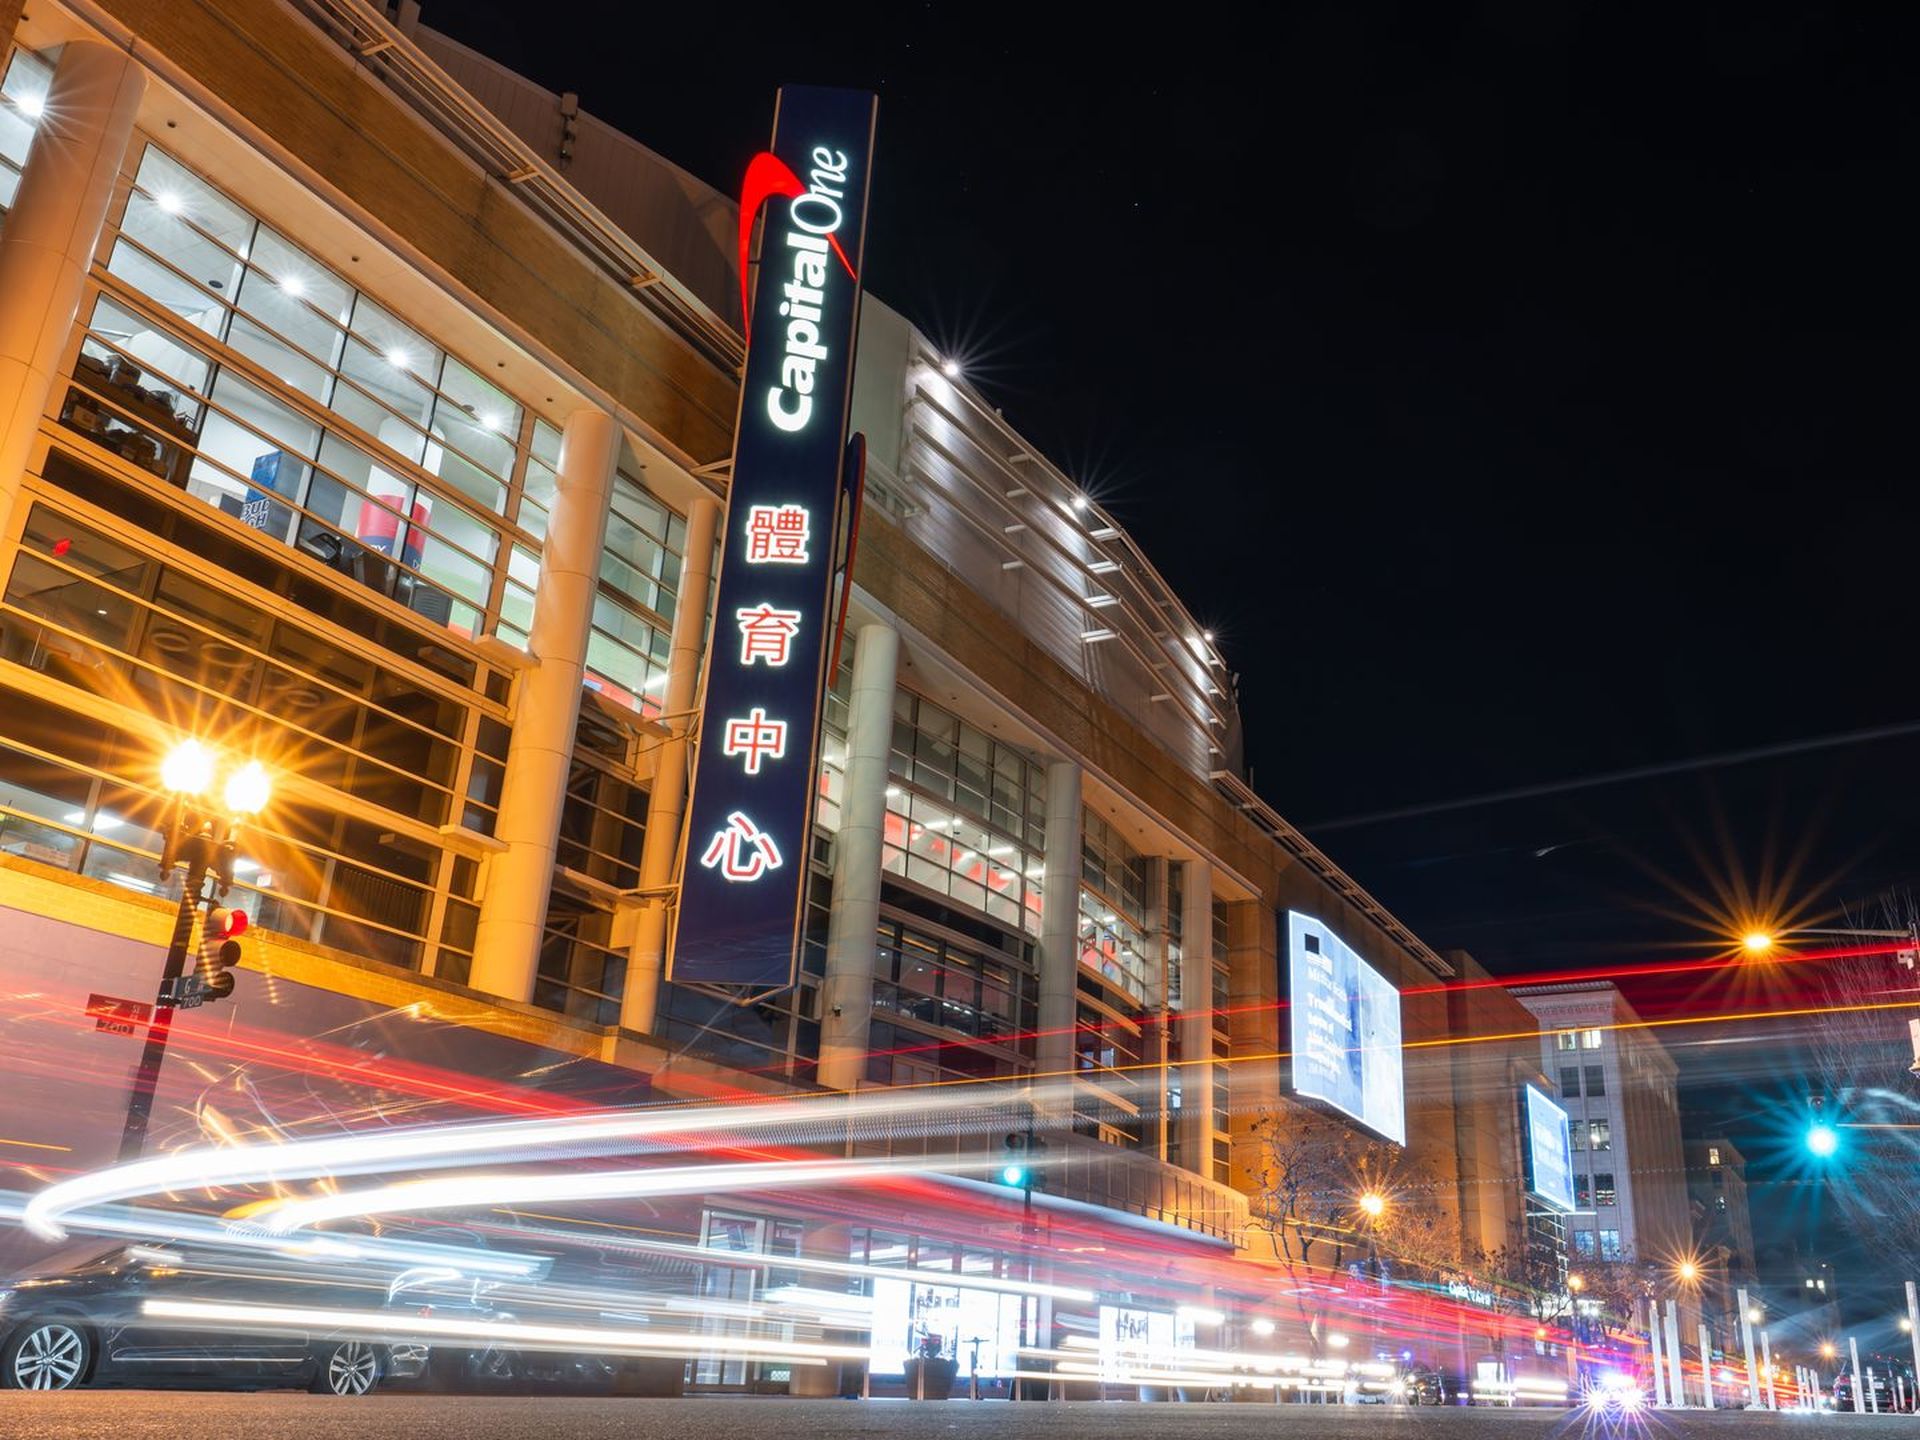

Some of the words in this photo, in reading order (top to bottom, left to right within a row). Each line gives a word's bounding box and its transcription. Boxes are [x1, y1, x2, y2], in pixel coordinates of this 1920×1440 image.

[790, 146, 848, 235] One
[767, 232, 829, 432] Capital
[701, 505, 810, 881] 體育中心
[182, 995, 201, 1009] 700
